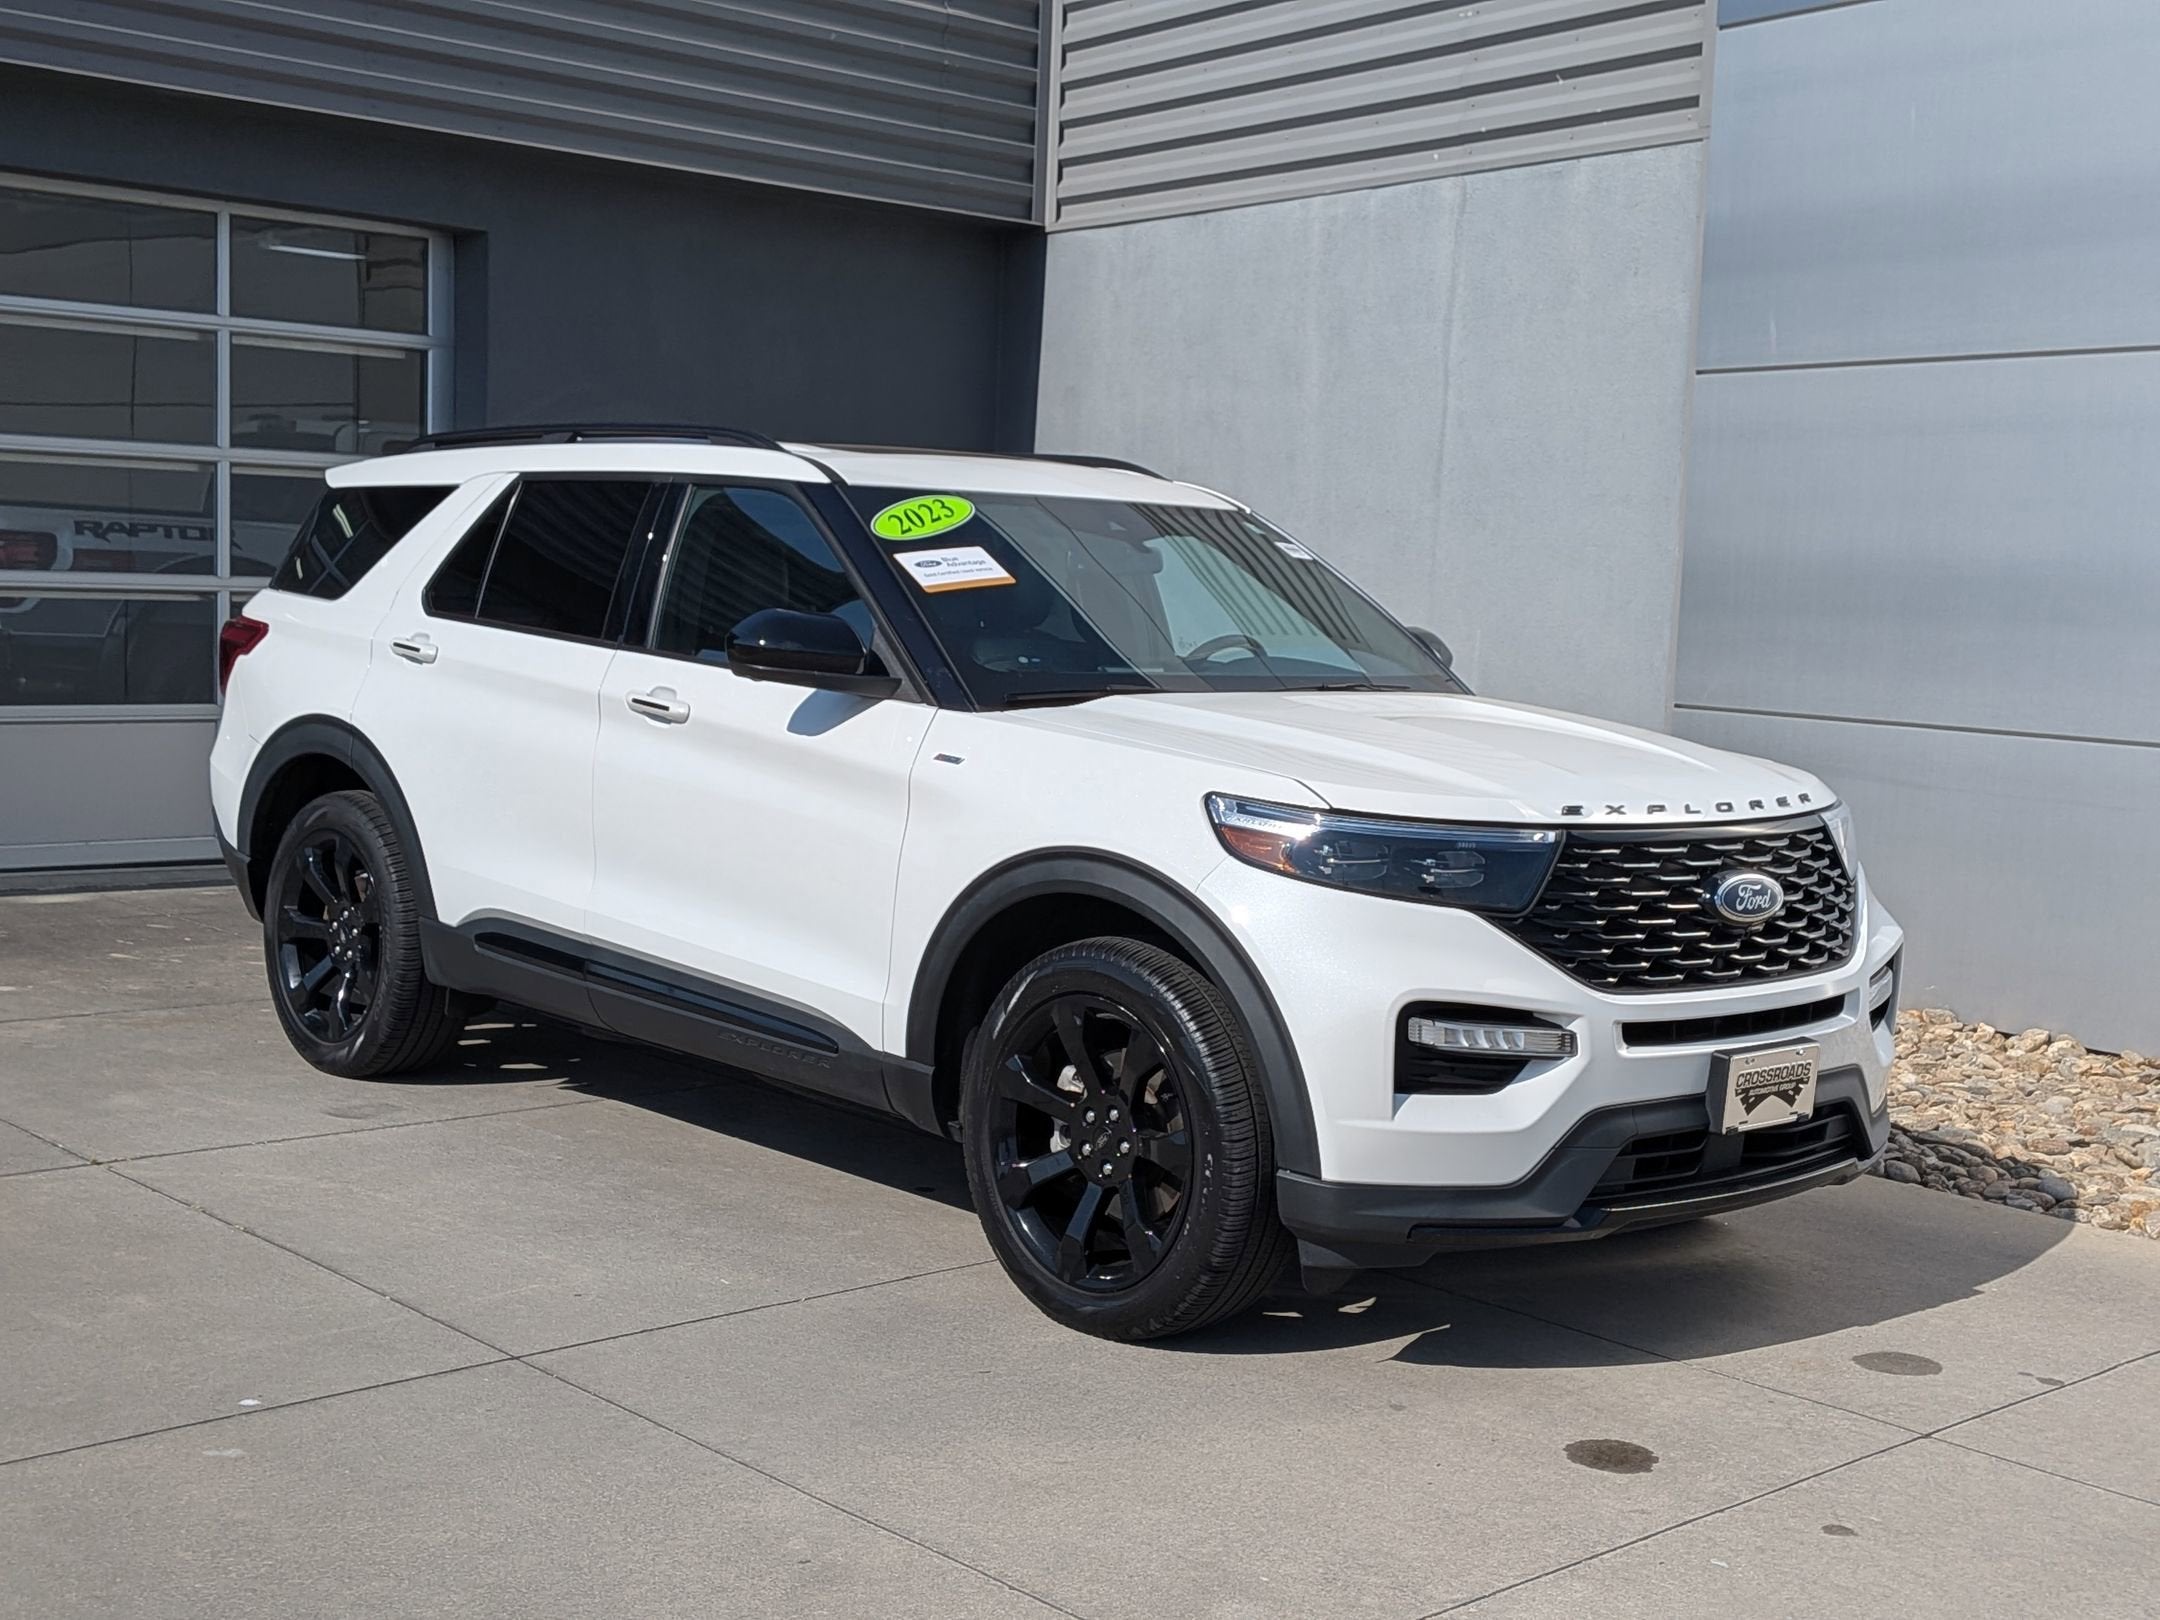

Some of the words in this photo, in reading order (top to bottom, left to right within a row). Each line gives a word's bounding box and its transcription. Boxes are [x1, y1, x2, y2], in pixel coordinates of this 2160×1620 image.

[888, 499, 955, 536] 2023
[946, 559, 986, 568] Advantage
[1561, 793, 1811, 816] EXPLORER
[1736, 884, 1771, 910] Ford
[717, 1032, 831, 1069] EXPLORER
[1735, 1062, 1812, 1088] CROSSROADS
